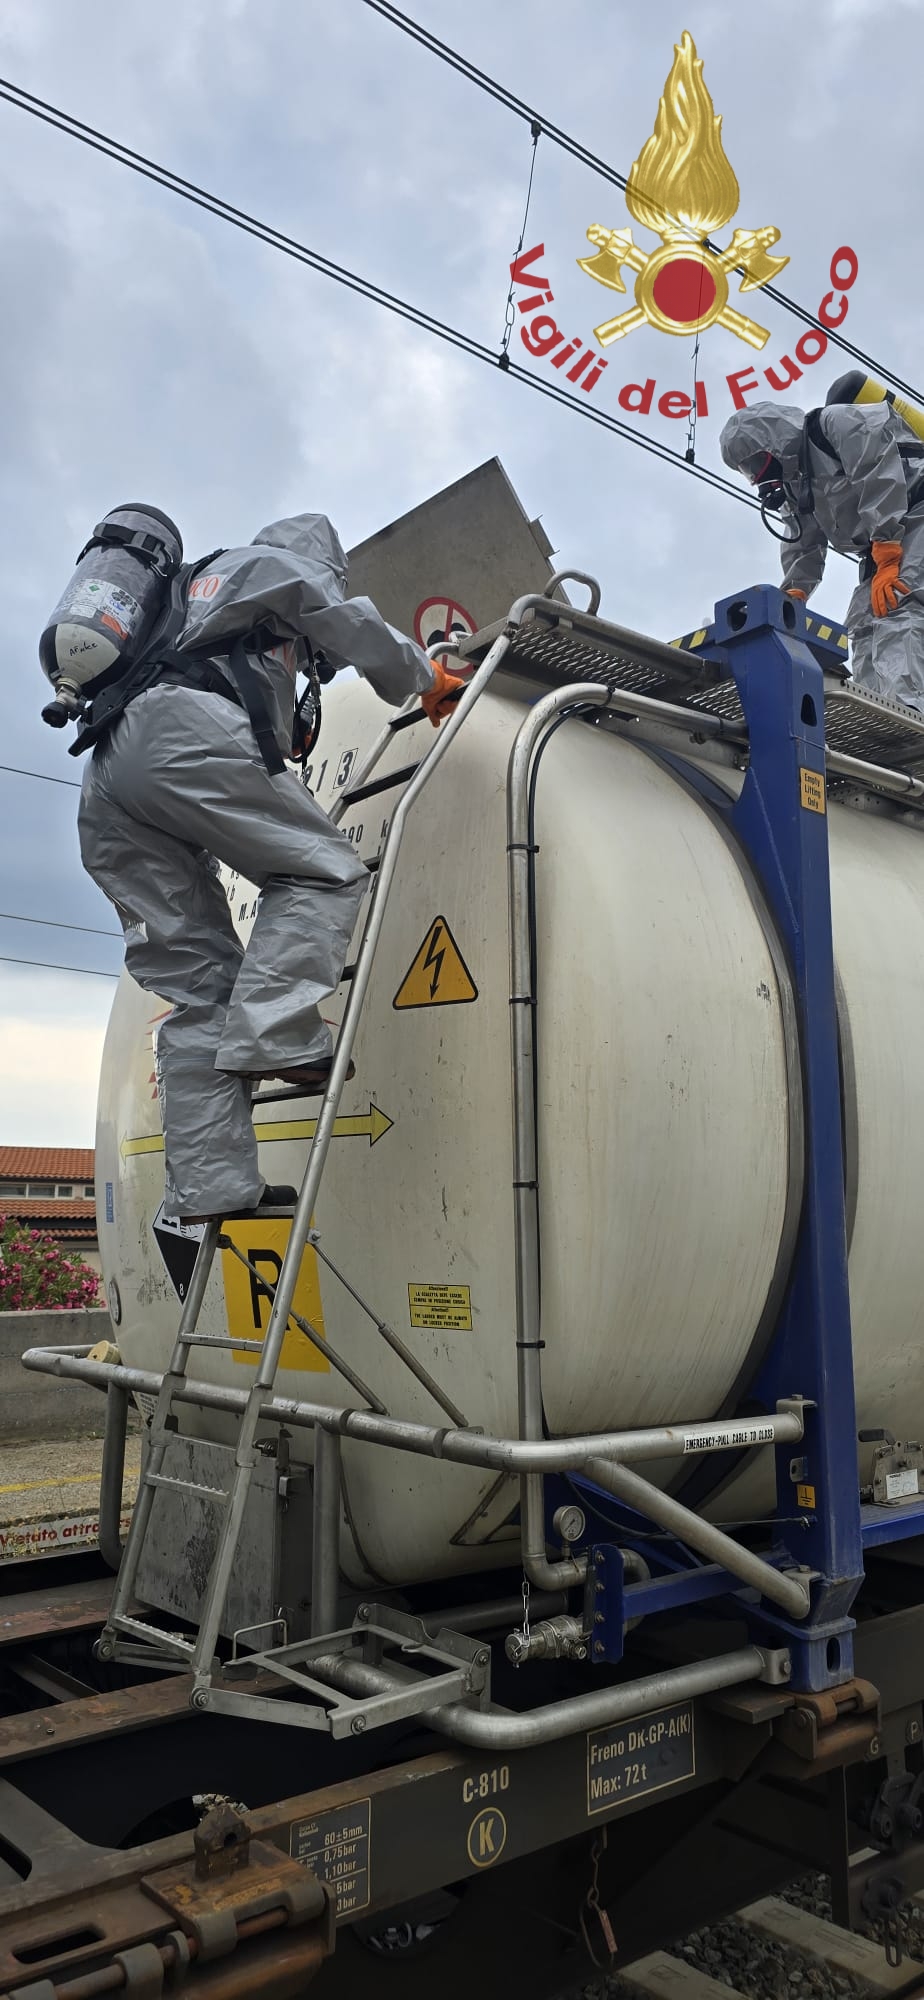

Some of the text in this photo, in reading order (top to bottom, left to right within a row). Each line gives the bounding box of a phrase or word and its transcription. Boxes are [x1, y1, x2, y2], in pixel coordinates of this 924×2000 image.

[337, 751, 354, 786] 3
[805, 773, 820, 788] Empty
[805, 784, 821, 799] Lifting
[808, 797, 819, 809] Only
[179, 1283, 185, 1297] 8
[248, 1249, 291, 1331] R
[732, 1432, 748, 1444] CABLE
[750, 1430, 757, 1442] TO
[758, 1428, 774, 1441] CLOSE
[591, 1740, 625, 1765] Freno
[463, 1765, 509, 1803] C-810
[591, 1775, 621, 1800] Max:
[480, 1817, 494, 1856] K
